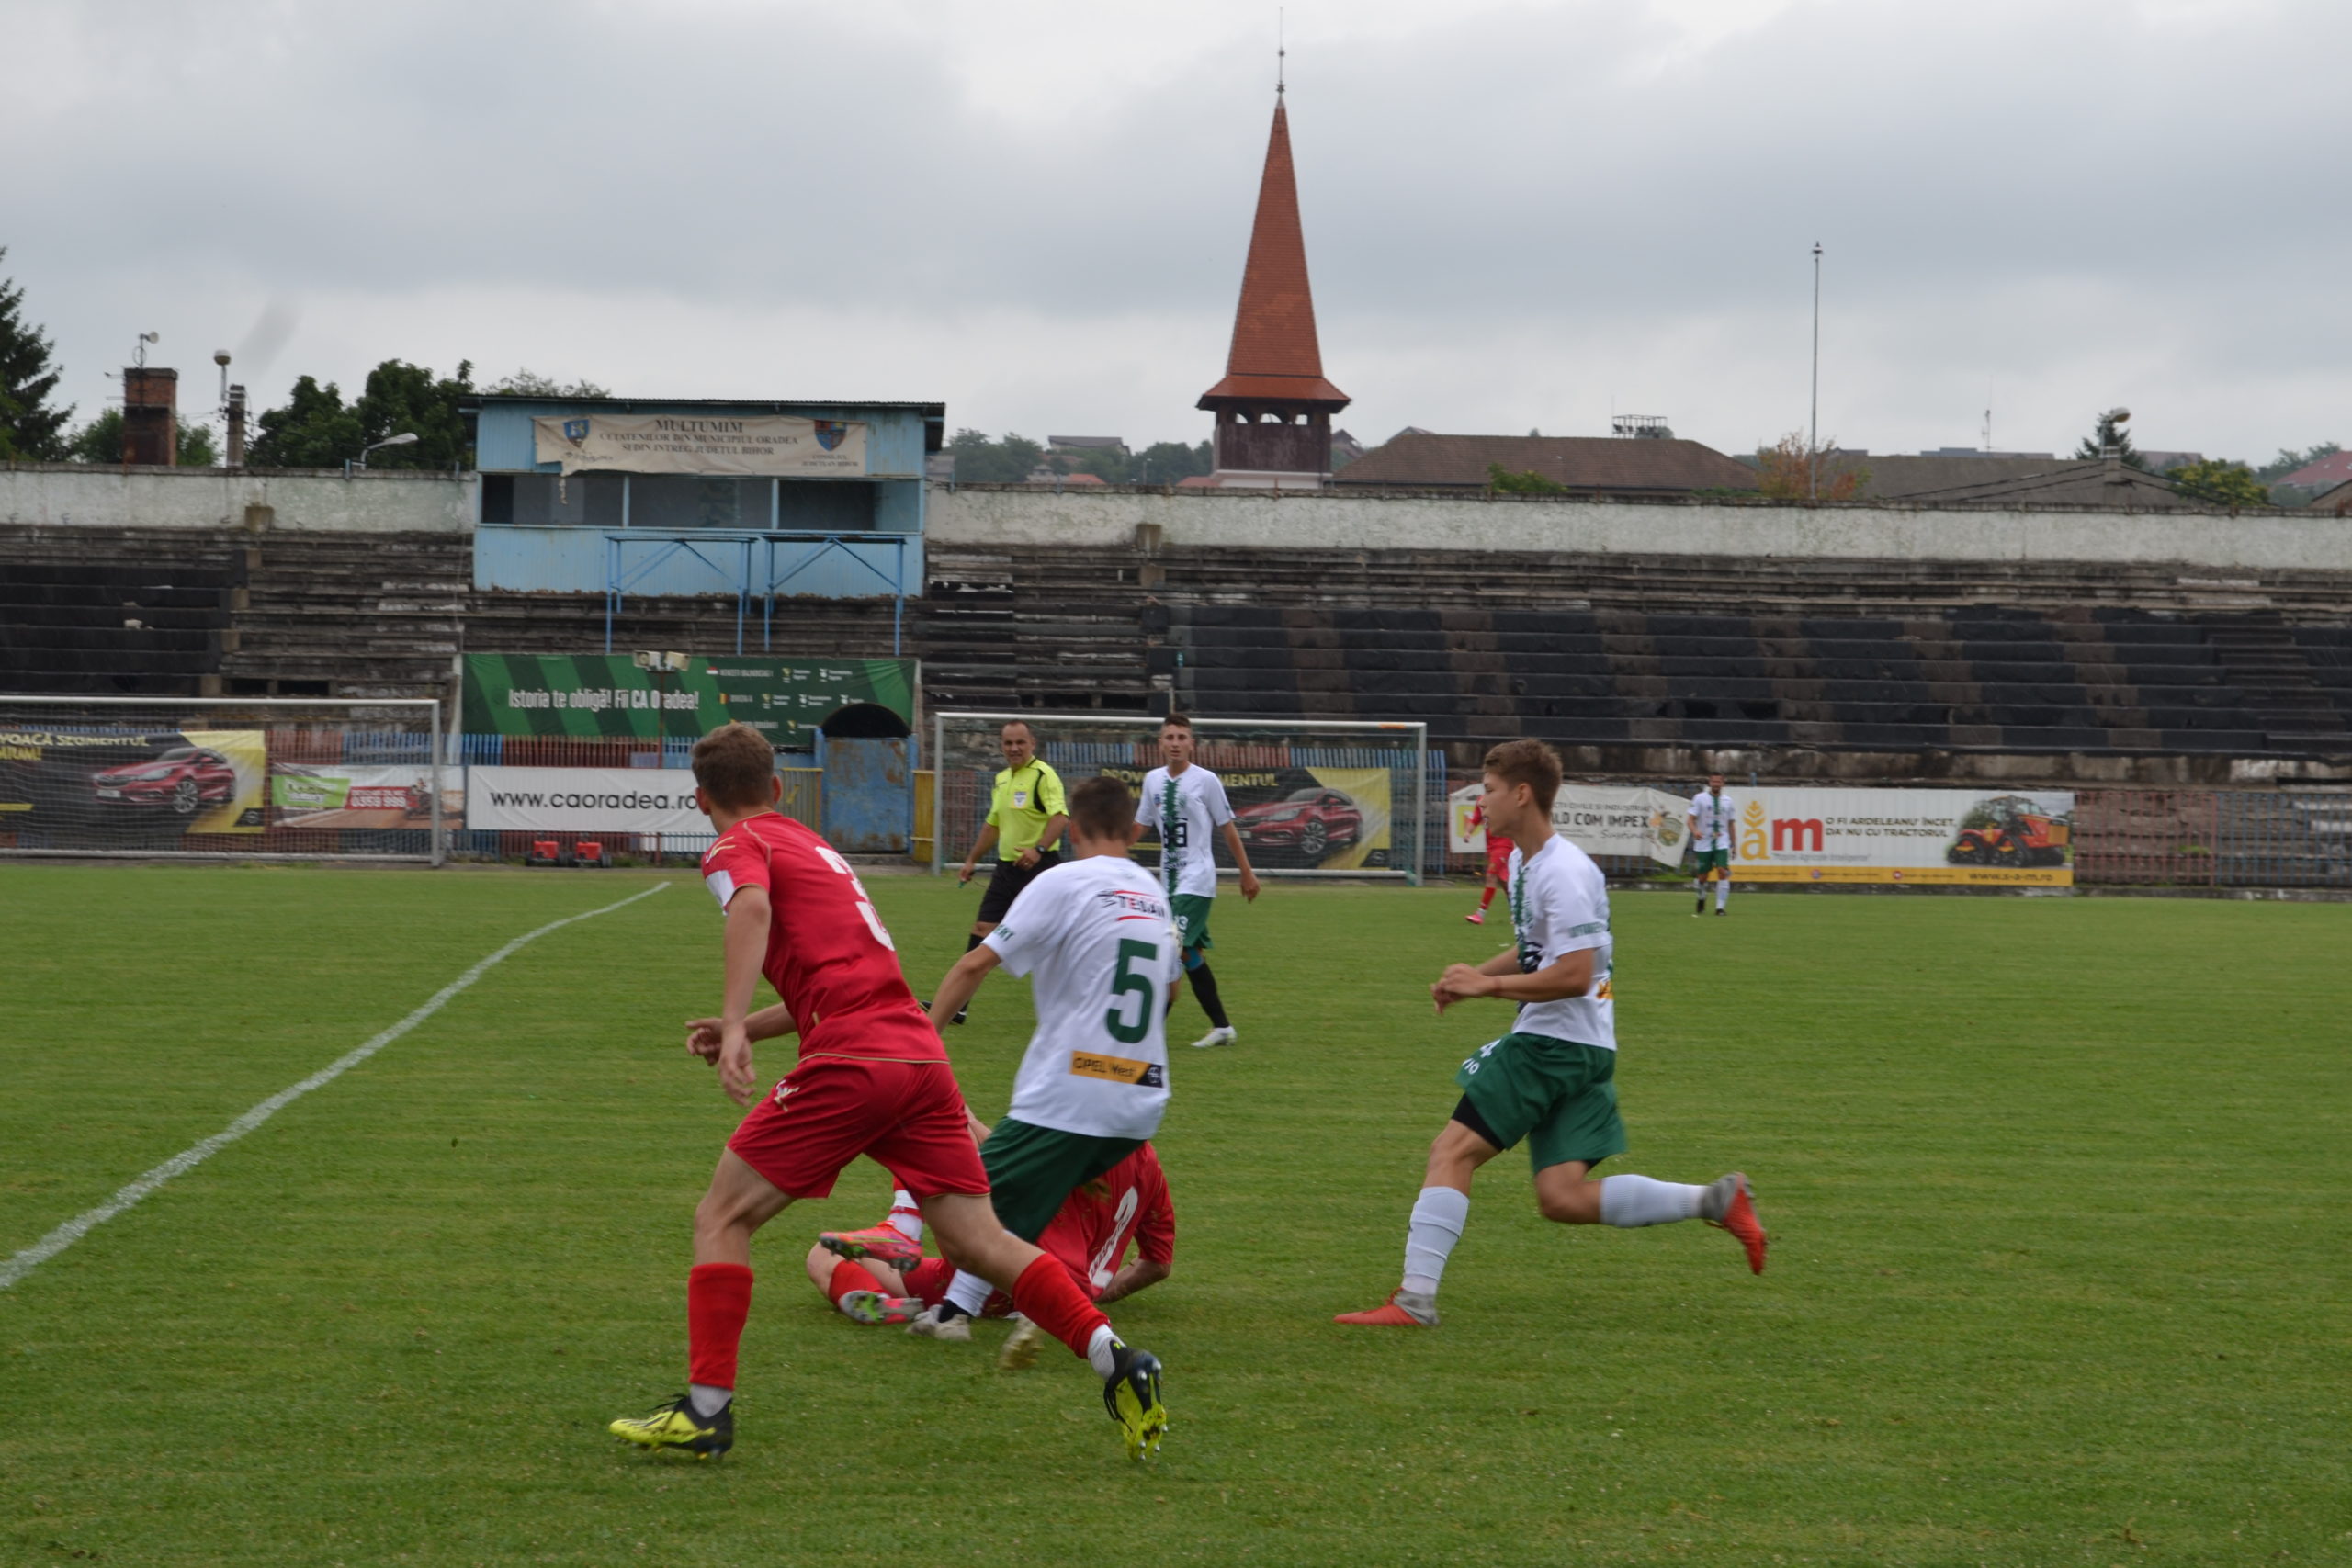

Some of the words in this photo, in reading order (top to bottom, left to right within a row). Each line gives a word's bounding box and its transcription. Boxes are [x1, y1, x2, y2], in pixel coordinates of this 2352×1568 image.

[756, 435, 798, 445] ORADEA
[741, 446, 774, 456] BIHOR
[508, 688, 550, 709] Istoria
[552, 689, 567, 709] te
[569, 687, 612, 713] obligă!
[631, 689, 649, 710] CA
[490, 791, 698, 809] www.caoradea.ro
[1574, 812, 1603, 826] COM
[1608, 814, 1650, 828] IMPEX
[1825, 817, 1835, 826] O
[1838, 818, 1848, 826] FI
[1846, 828, 1862, 837] NU
[1865, 829, 1882, 837] CU
[1883, 829, 1949, 838] TRACTORUL
[1106, 937, 1159, 1044] 5
